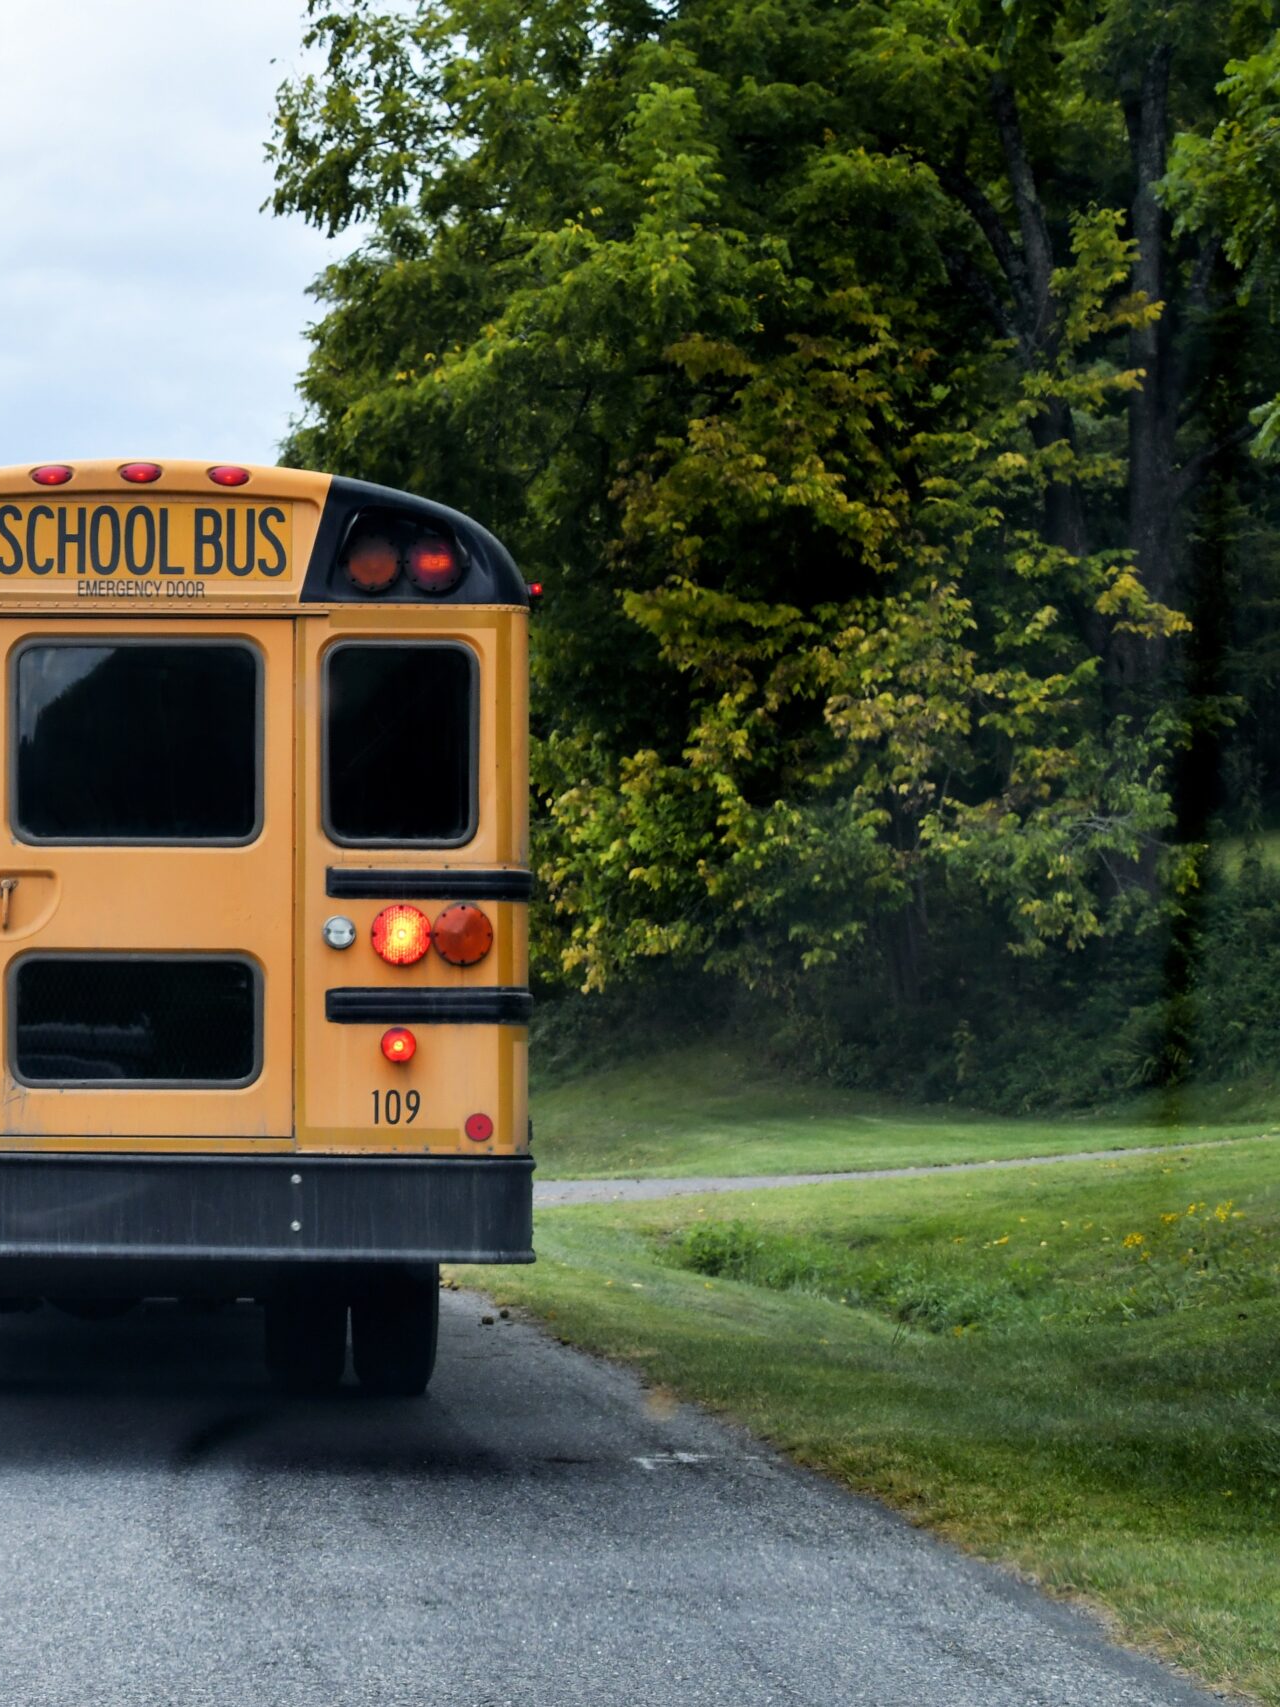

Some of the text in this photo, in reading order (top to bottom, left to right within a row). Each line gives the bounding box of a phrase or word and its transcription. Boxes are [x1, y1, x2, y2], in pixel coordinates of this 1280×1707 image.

[193, 507, 287, 577] BUS
[76, 580, 206, 599] EMERGENCY DOOR
[371, 1089, 421, 1125] 109
